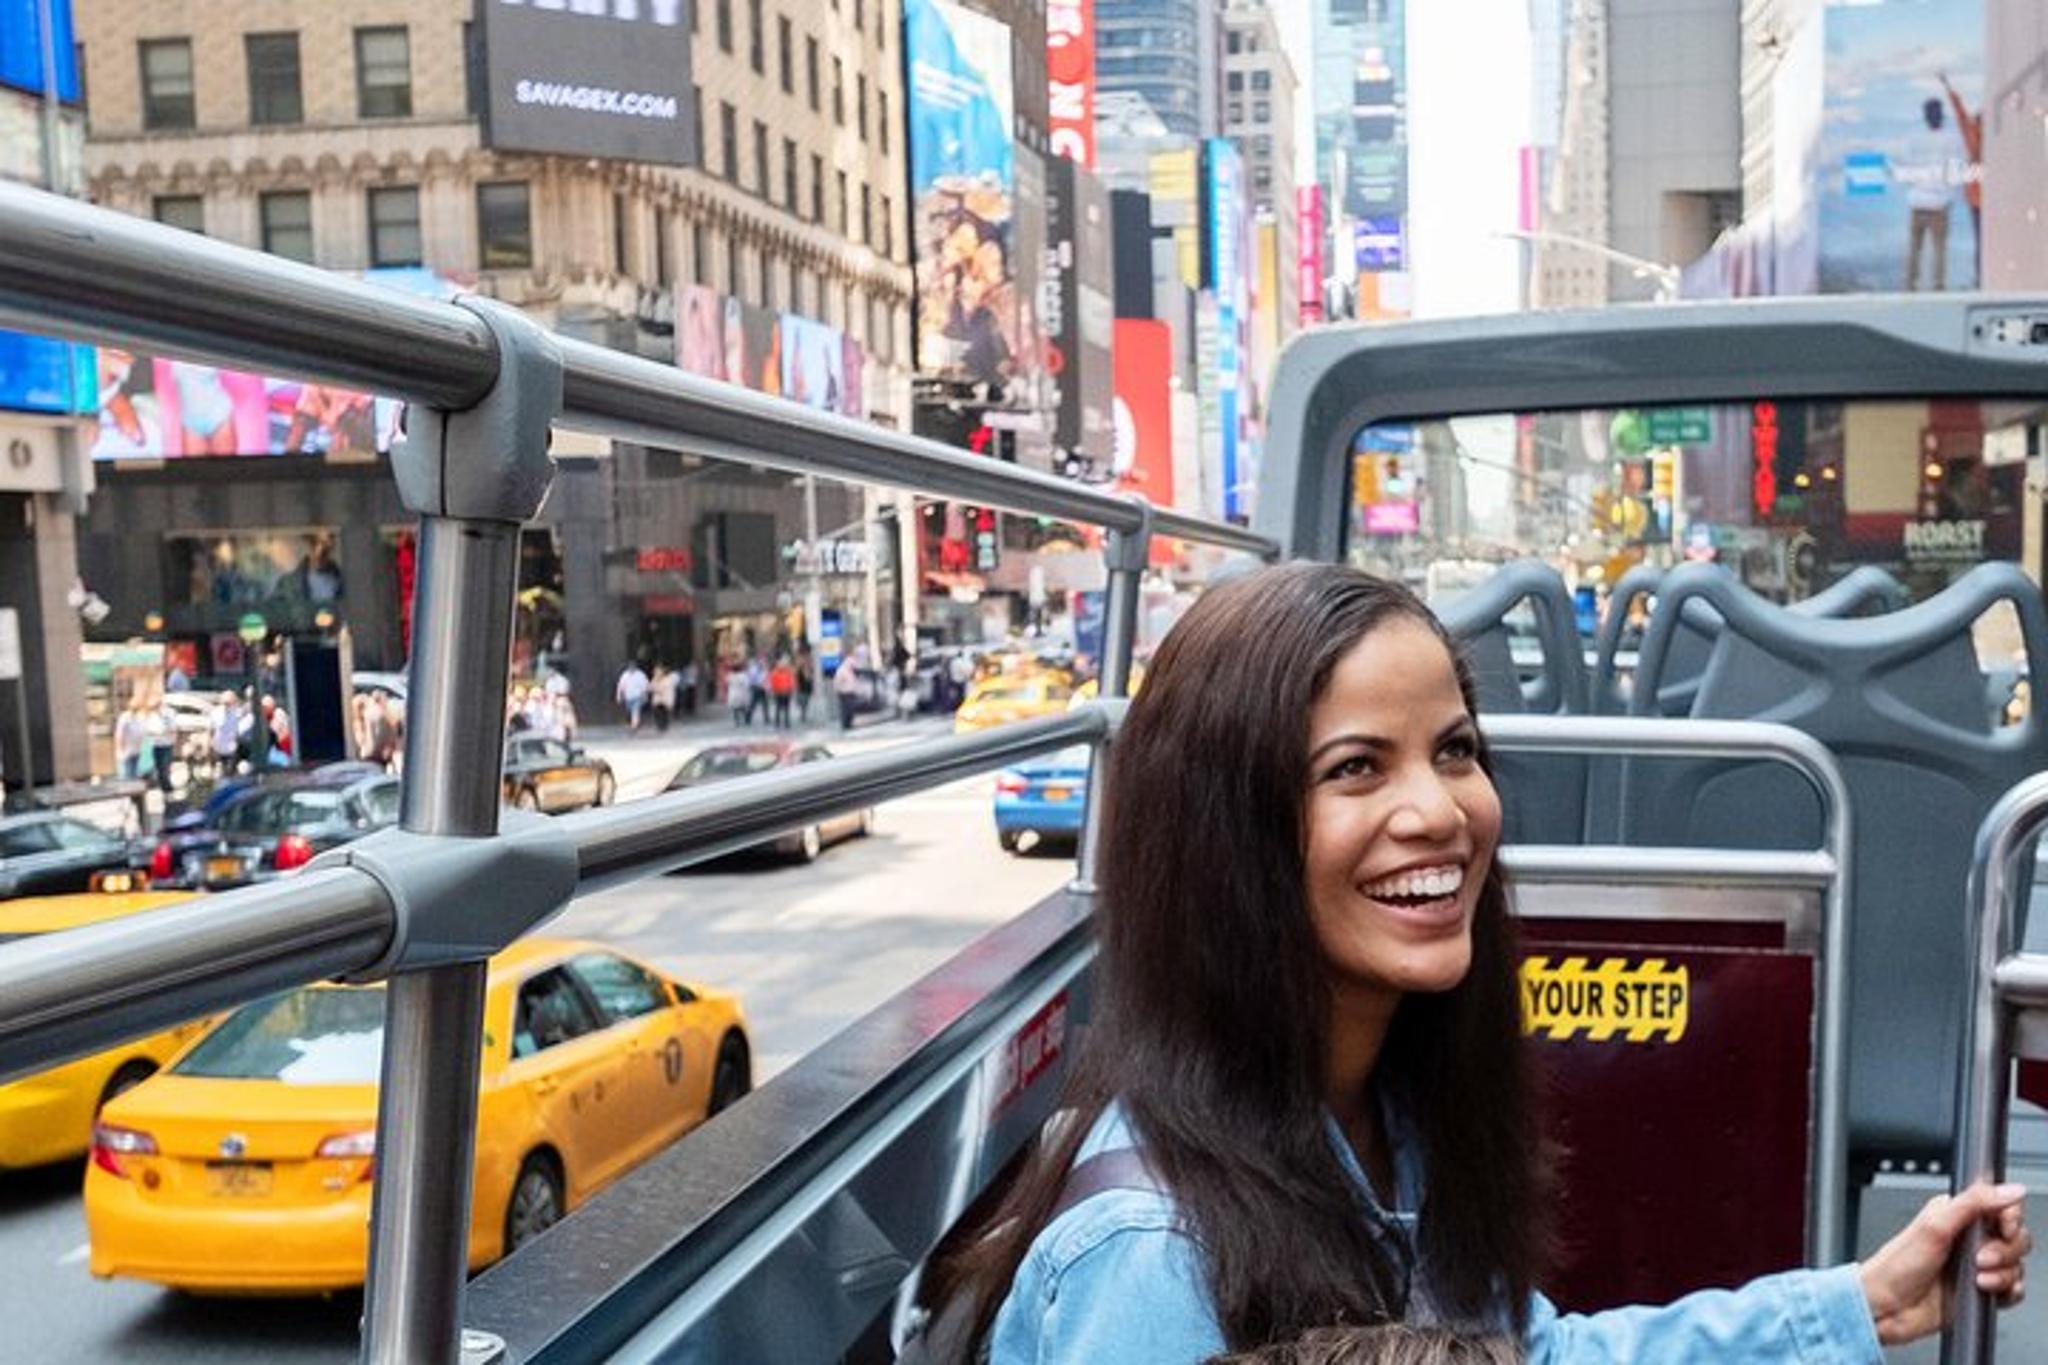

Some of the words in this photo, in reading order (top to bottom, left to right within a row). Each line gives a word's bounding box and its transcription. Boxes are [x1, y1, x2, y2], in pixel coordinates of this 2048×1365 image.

[515, 79, 678, 119] SAVAGEX.COM
[1528, 980, 1603, 1017] YOUR
[1614, 982, 1683, 1018] STEP
